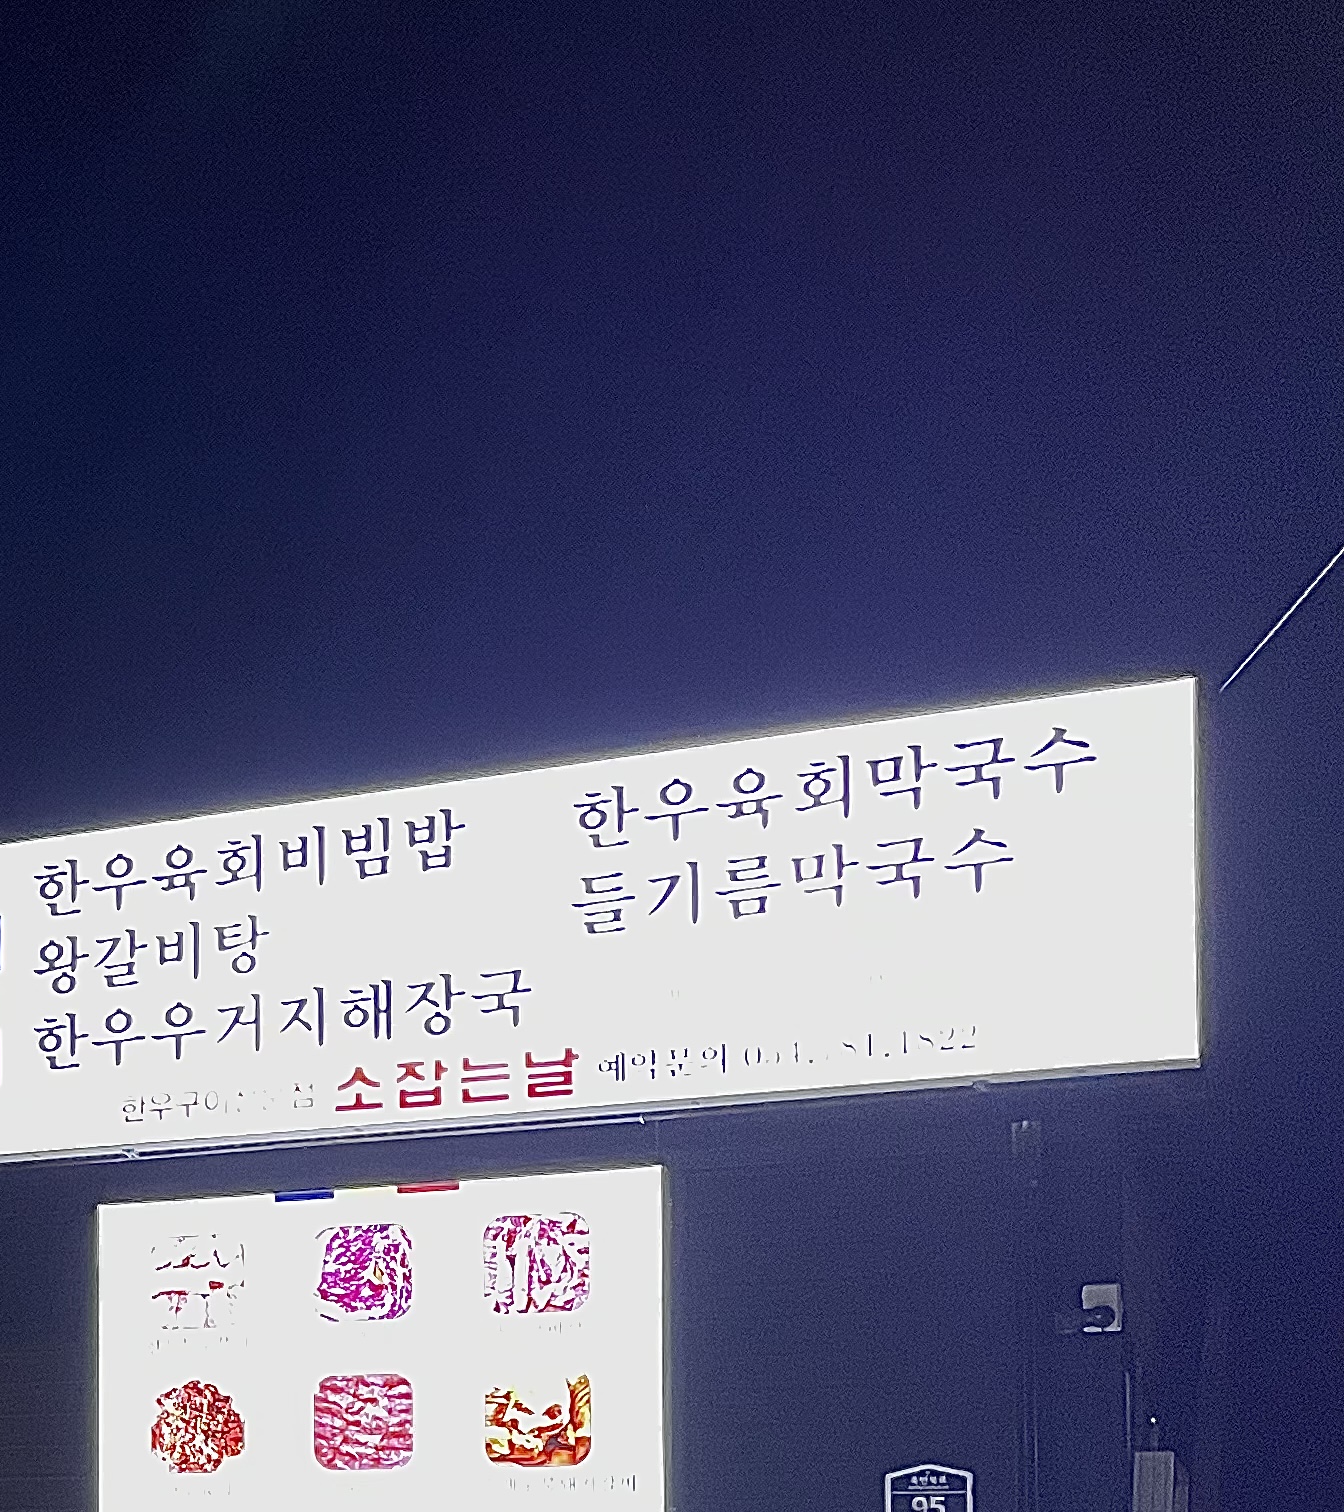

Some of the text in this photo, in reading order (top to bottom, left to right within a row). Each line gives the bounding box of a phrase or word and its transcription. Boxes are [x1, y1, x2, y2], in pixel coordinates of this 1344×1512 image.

[572, 725, 1099, 849] 한우육회막국수
[32, 807, 467, 917] 한우육회비빔밥
[570, 826, 1016, 936] 들기름막국수
[32, 913, 271, 996] 왕갈비탕
[32, 968, 534, 1070] 한우우거지해장국
[122, 1082, 314, 1123] 한우구이점
[334, 1047, 580, 1112] 소잡는날
